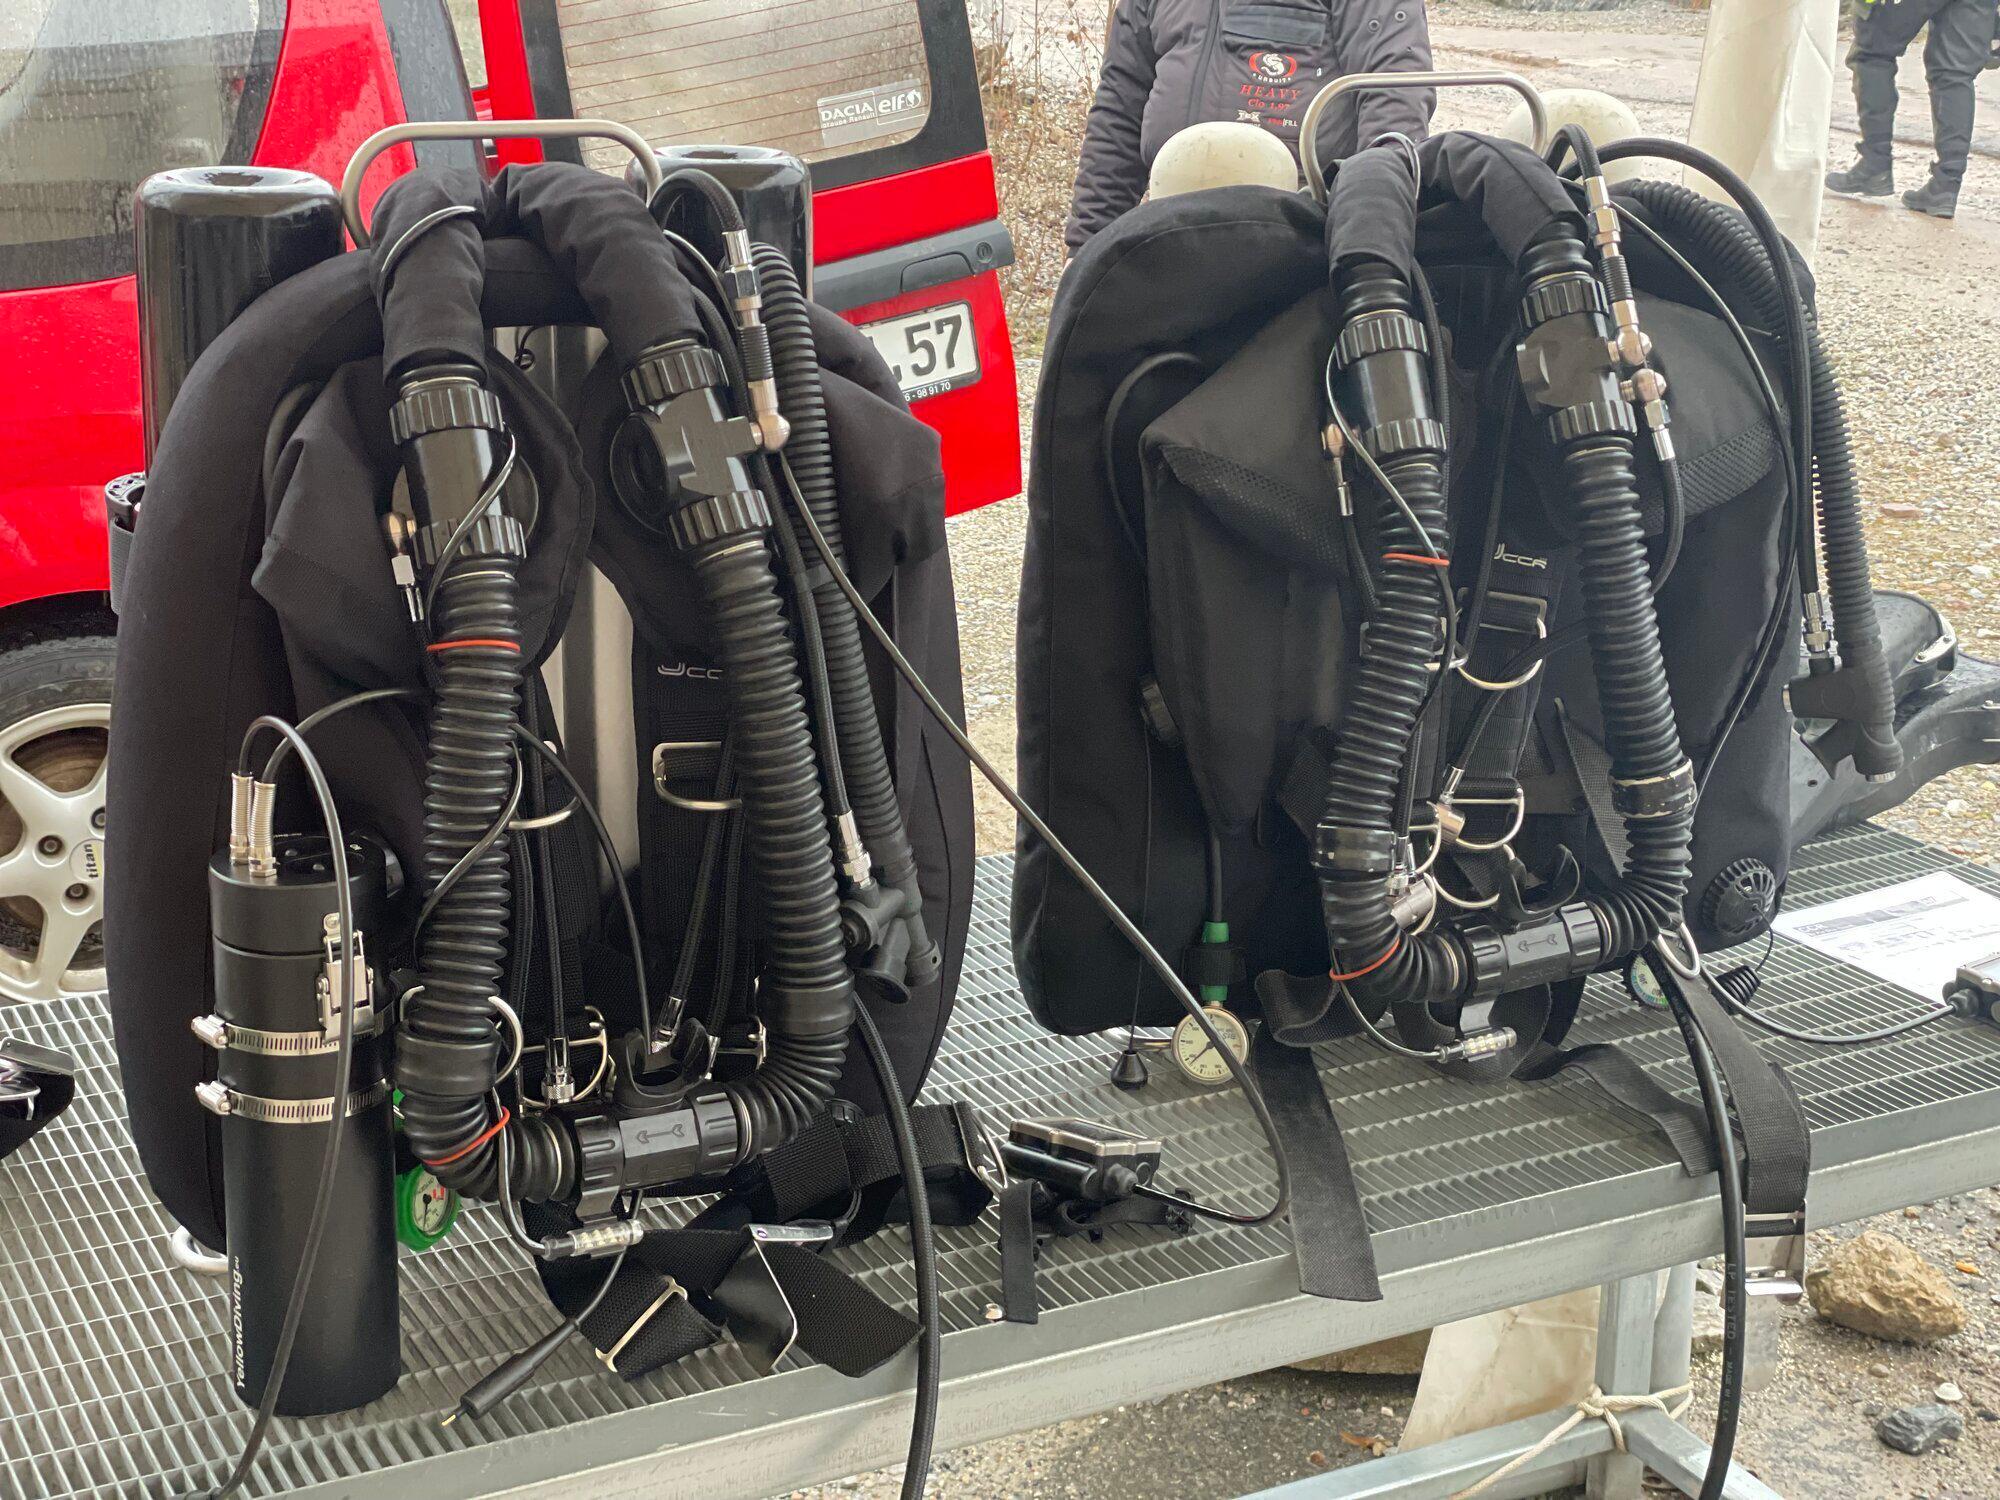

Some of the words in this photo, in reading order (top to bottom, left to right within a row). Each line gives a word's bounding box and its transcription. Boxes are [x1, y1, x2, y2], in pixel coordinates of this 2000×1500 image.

[1240, 84, 1301, 99] HEAVY
[820, 102, 874, 122] DACIA
[878, 94, 905, 113] elf
[905, 314, 962, 376] 57
[916, 388, 927, 398] 98
[928, 385, 939, 395] 91
[941, 381, 951, 391] 70
[657, 662, 724, 679] JCC
[83, 844, 99, 878] titan
[232, 1256, 245, 1389] YellowDiving.eu
[1727, 1290, 1737, 1339] TESTED
